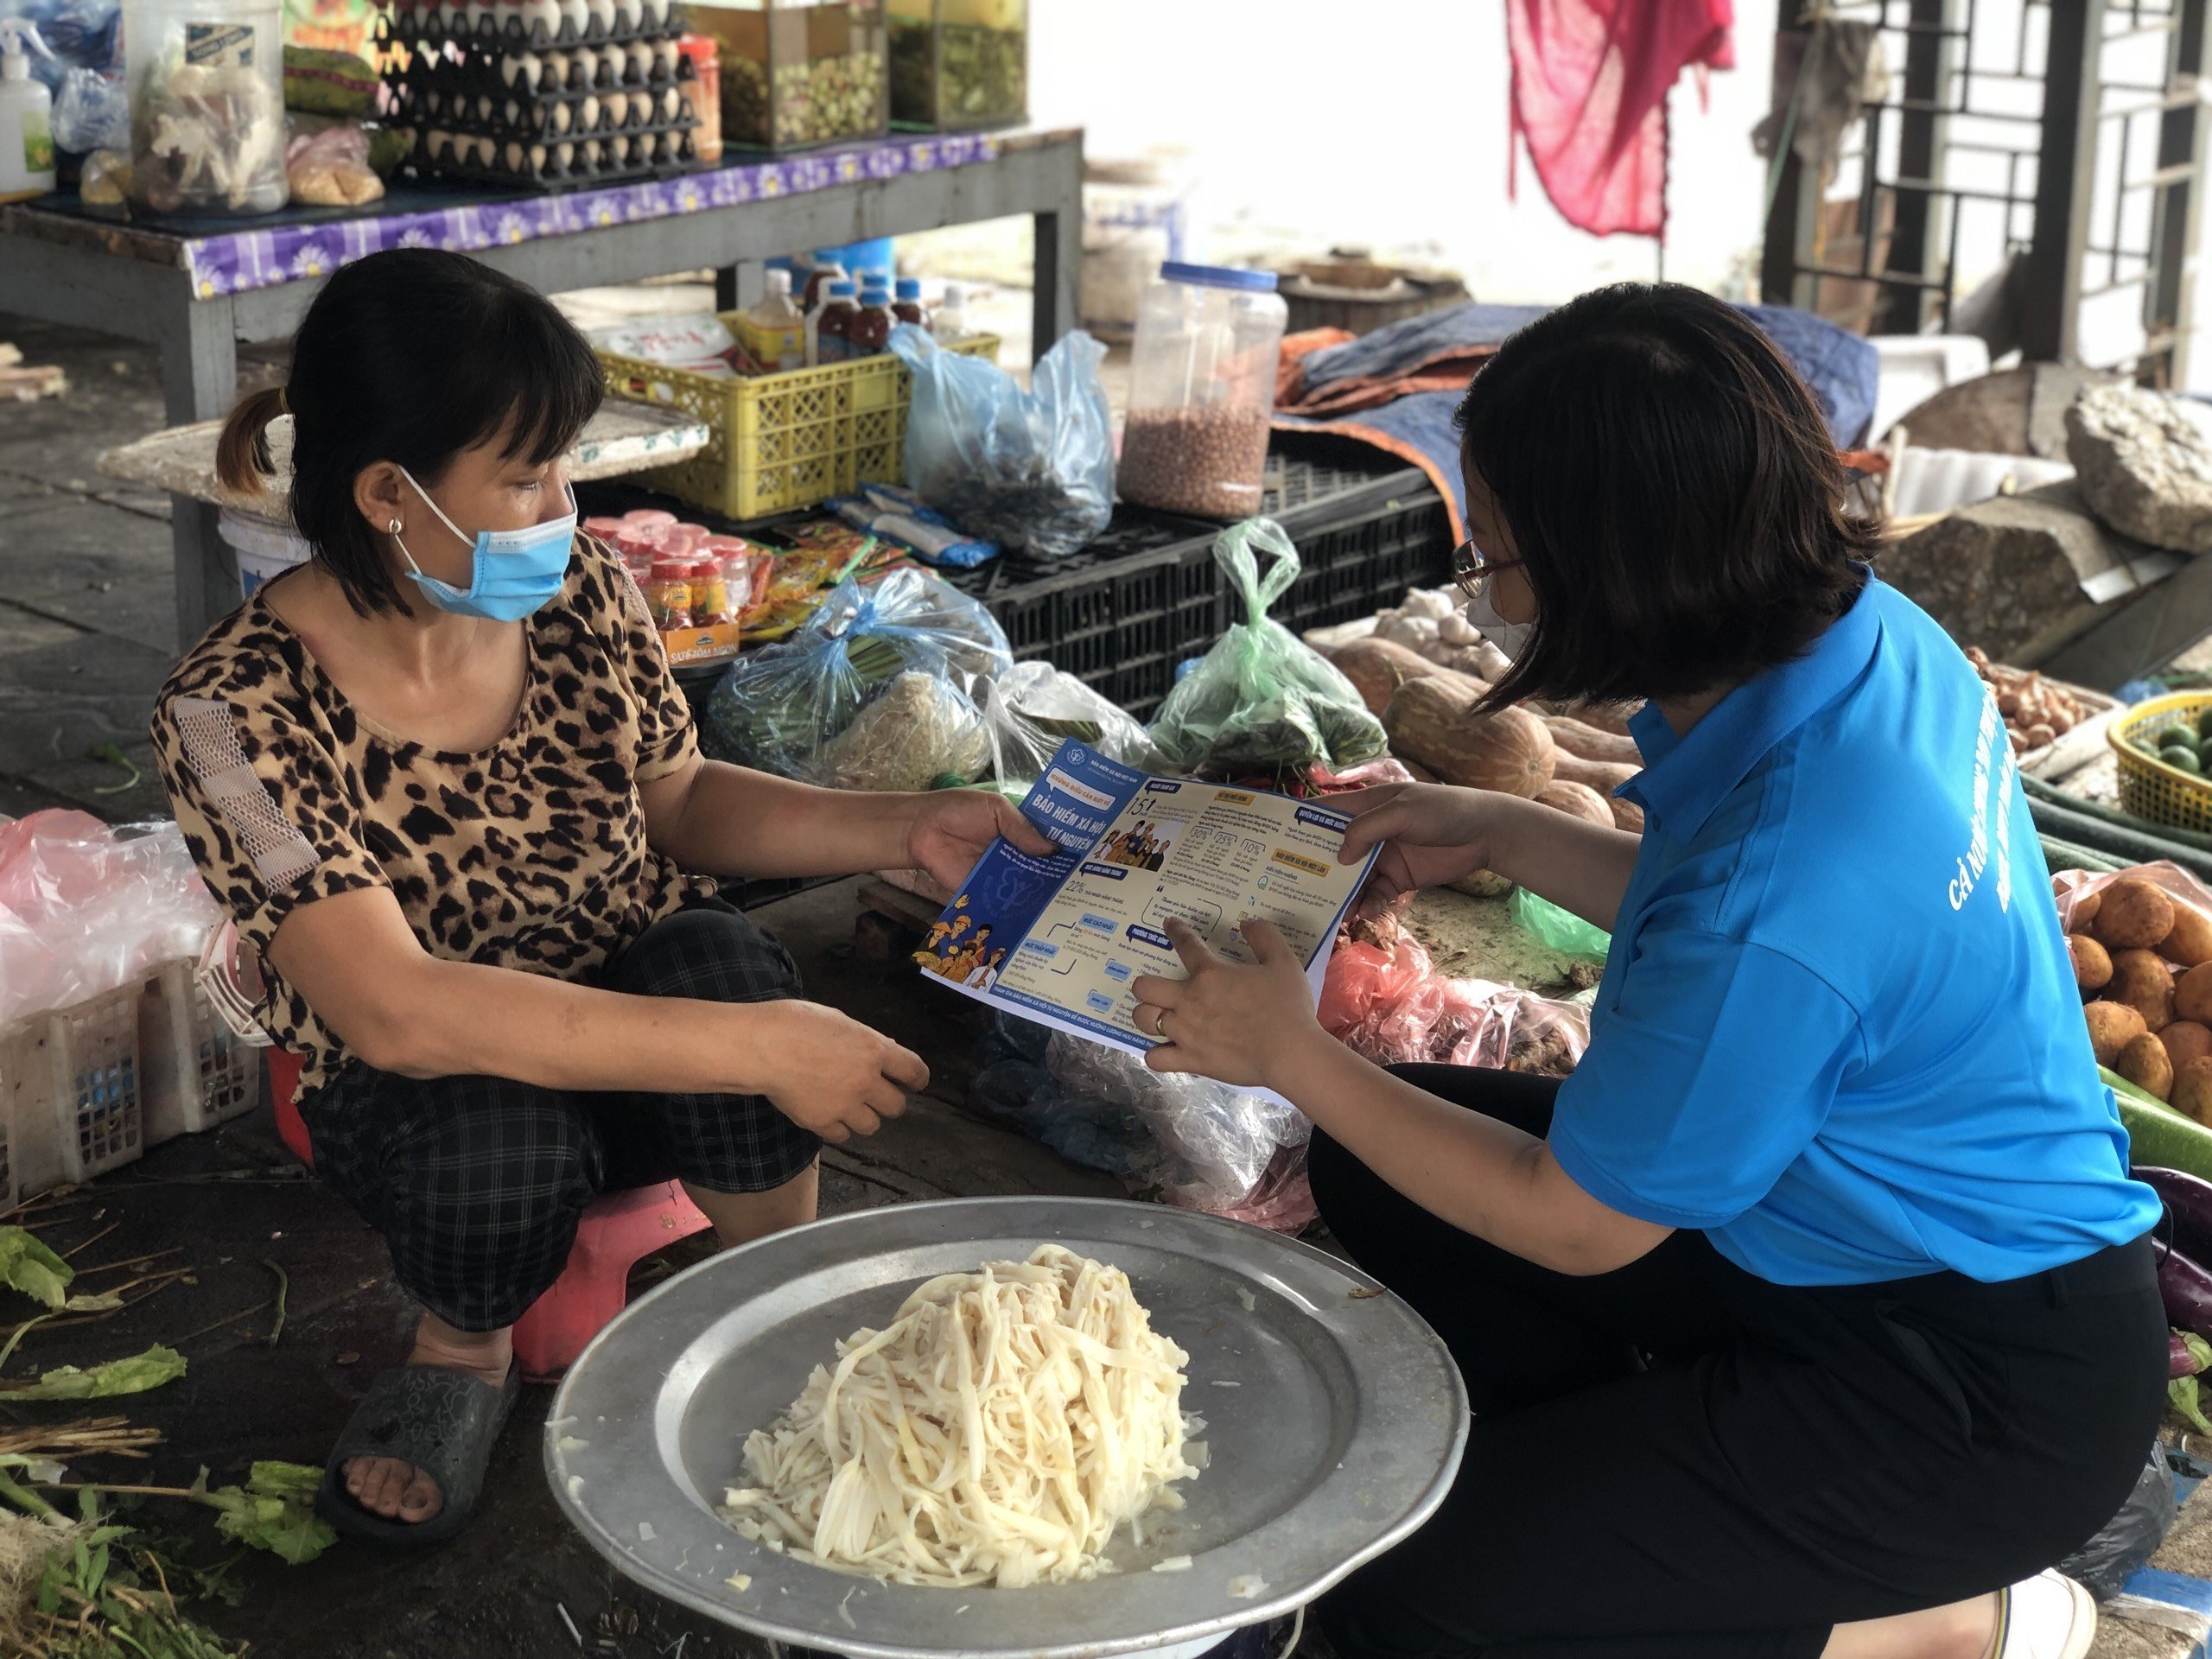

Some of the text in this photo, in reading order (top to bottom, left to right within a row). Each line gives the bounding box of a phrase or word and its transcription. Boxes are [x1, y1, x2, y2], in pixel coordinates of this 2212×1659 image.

[1126, 798, 1149, 815] 15
[1033, 794, 1106, 836] BẢO HIỂM XÃ HỘI
[1058, 832, 1094, 851] NGUYỆN
[1191, 830, 1208, 840] 30%
[1215, 835, 1233, 846] 25%
[1243, 842, 1263, 855] 10%
[1065, 880, 1085, 893] 22%
